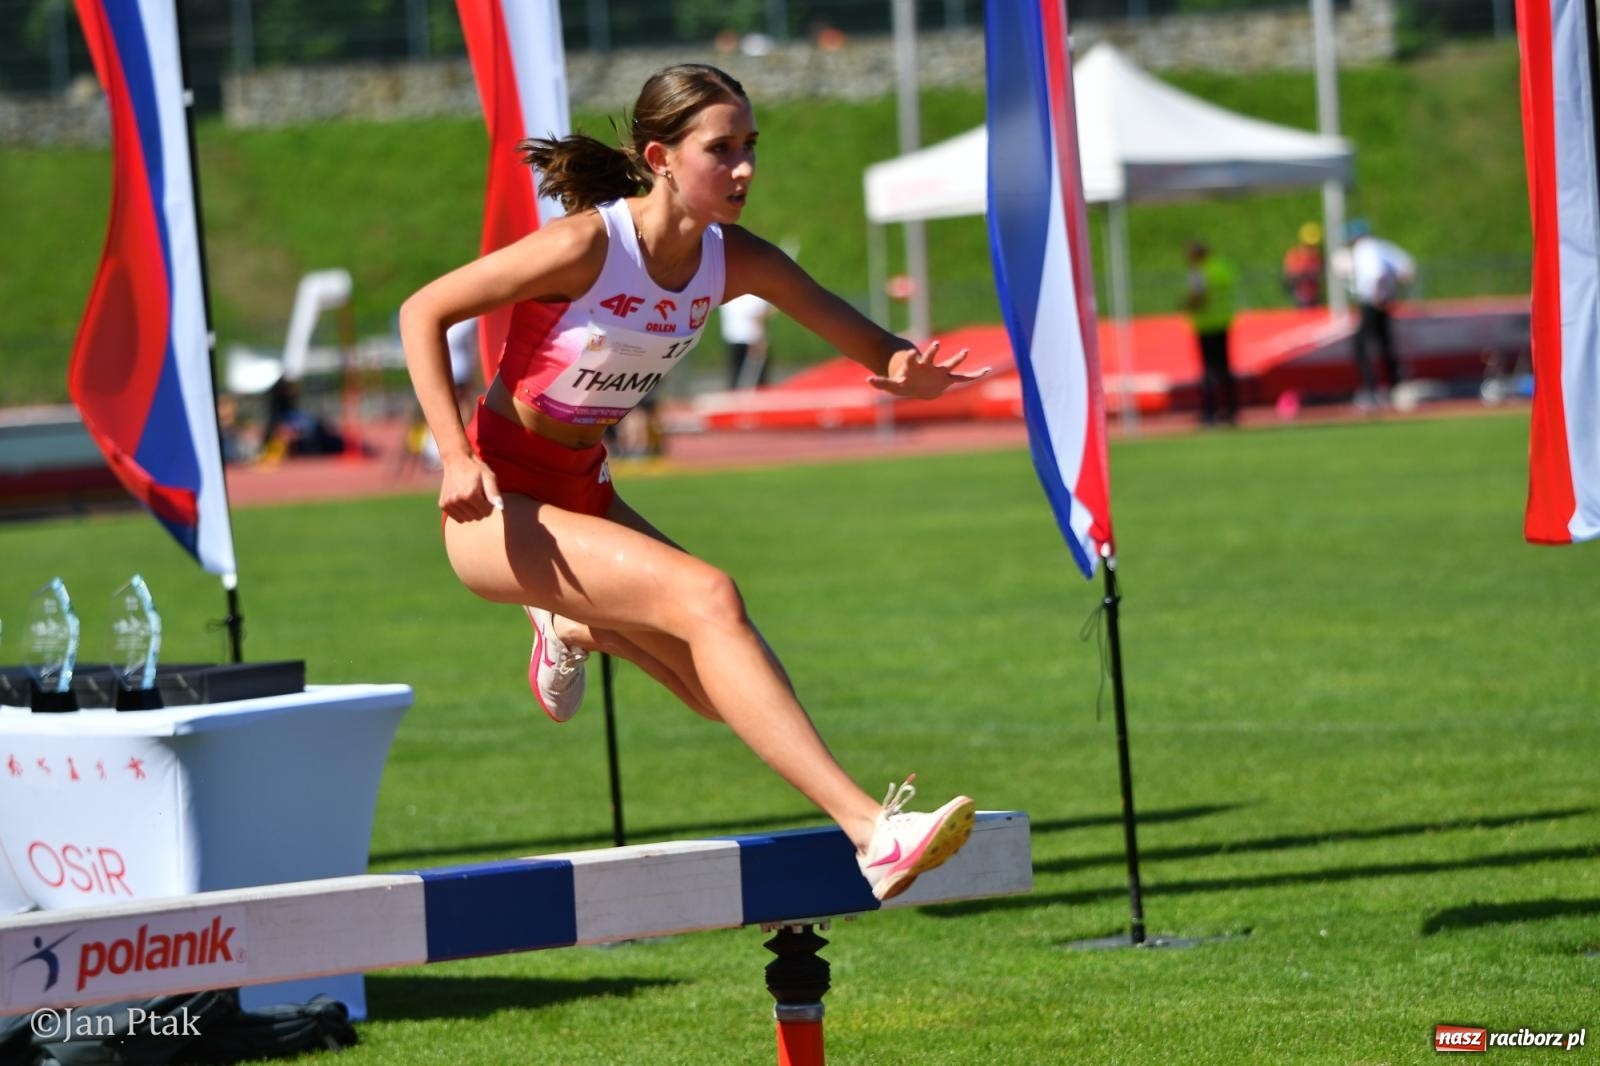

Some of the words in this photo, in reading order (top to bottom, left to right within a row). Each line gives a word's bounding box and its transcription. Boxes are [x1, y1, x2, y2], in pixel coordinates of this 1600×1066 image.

[600, 293, 645, 318] 4F
[646, 322, 676, 334] ORLEN
[27, 840, 134, 897] OSiR
[76, 915, 236, 992] polanik
